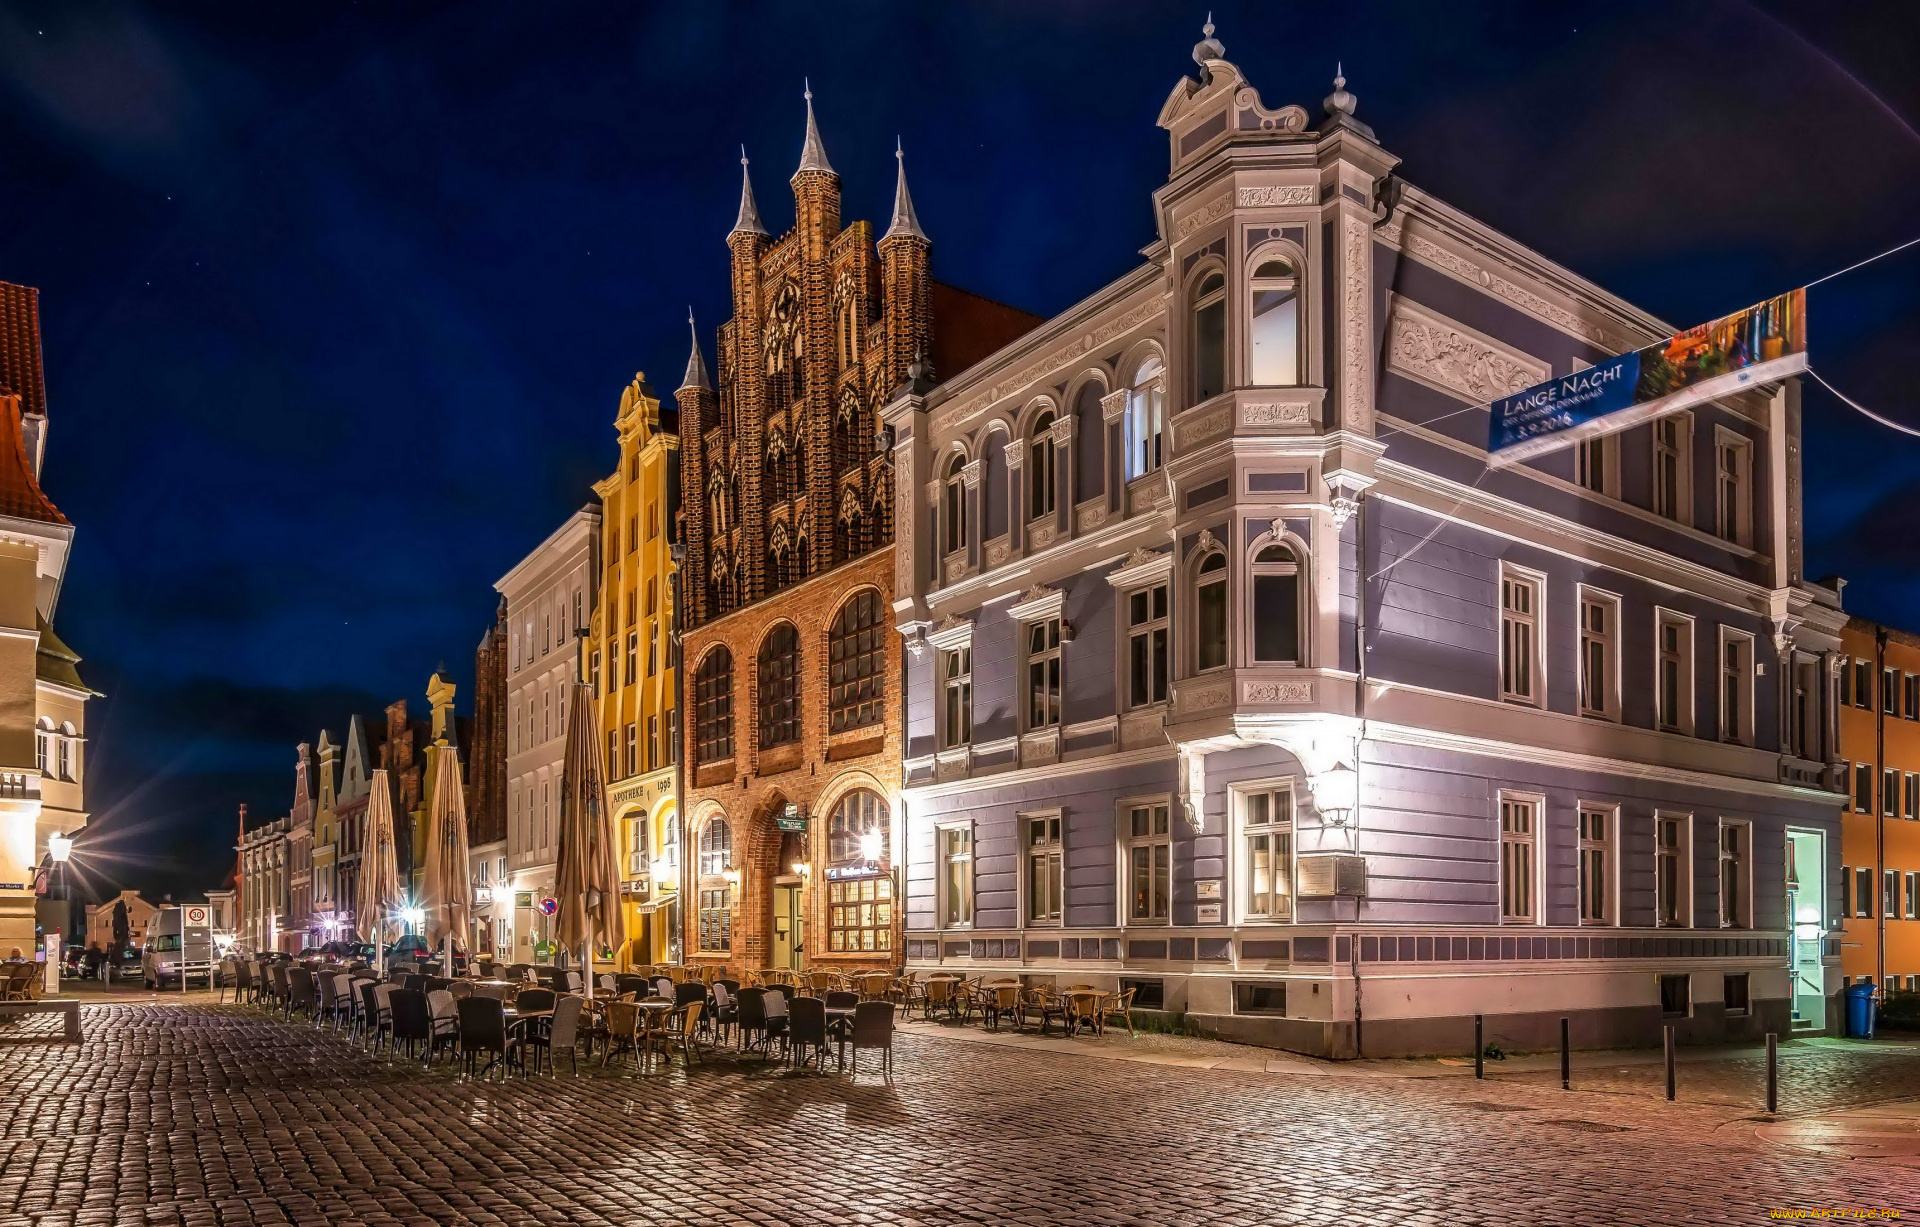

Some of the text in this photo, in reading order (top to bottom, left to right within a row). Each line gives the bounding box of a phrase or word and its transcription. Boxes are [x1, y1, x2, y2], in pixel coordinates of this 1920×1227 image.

[1504, 364, 1623, 416] LANGE NACHT
[613, 785, 644, 804] APOTHEKE
[192, 911, 202, 919] 30
